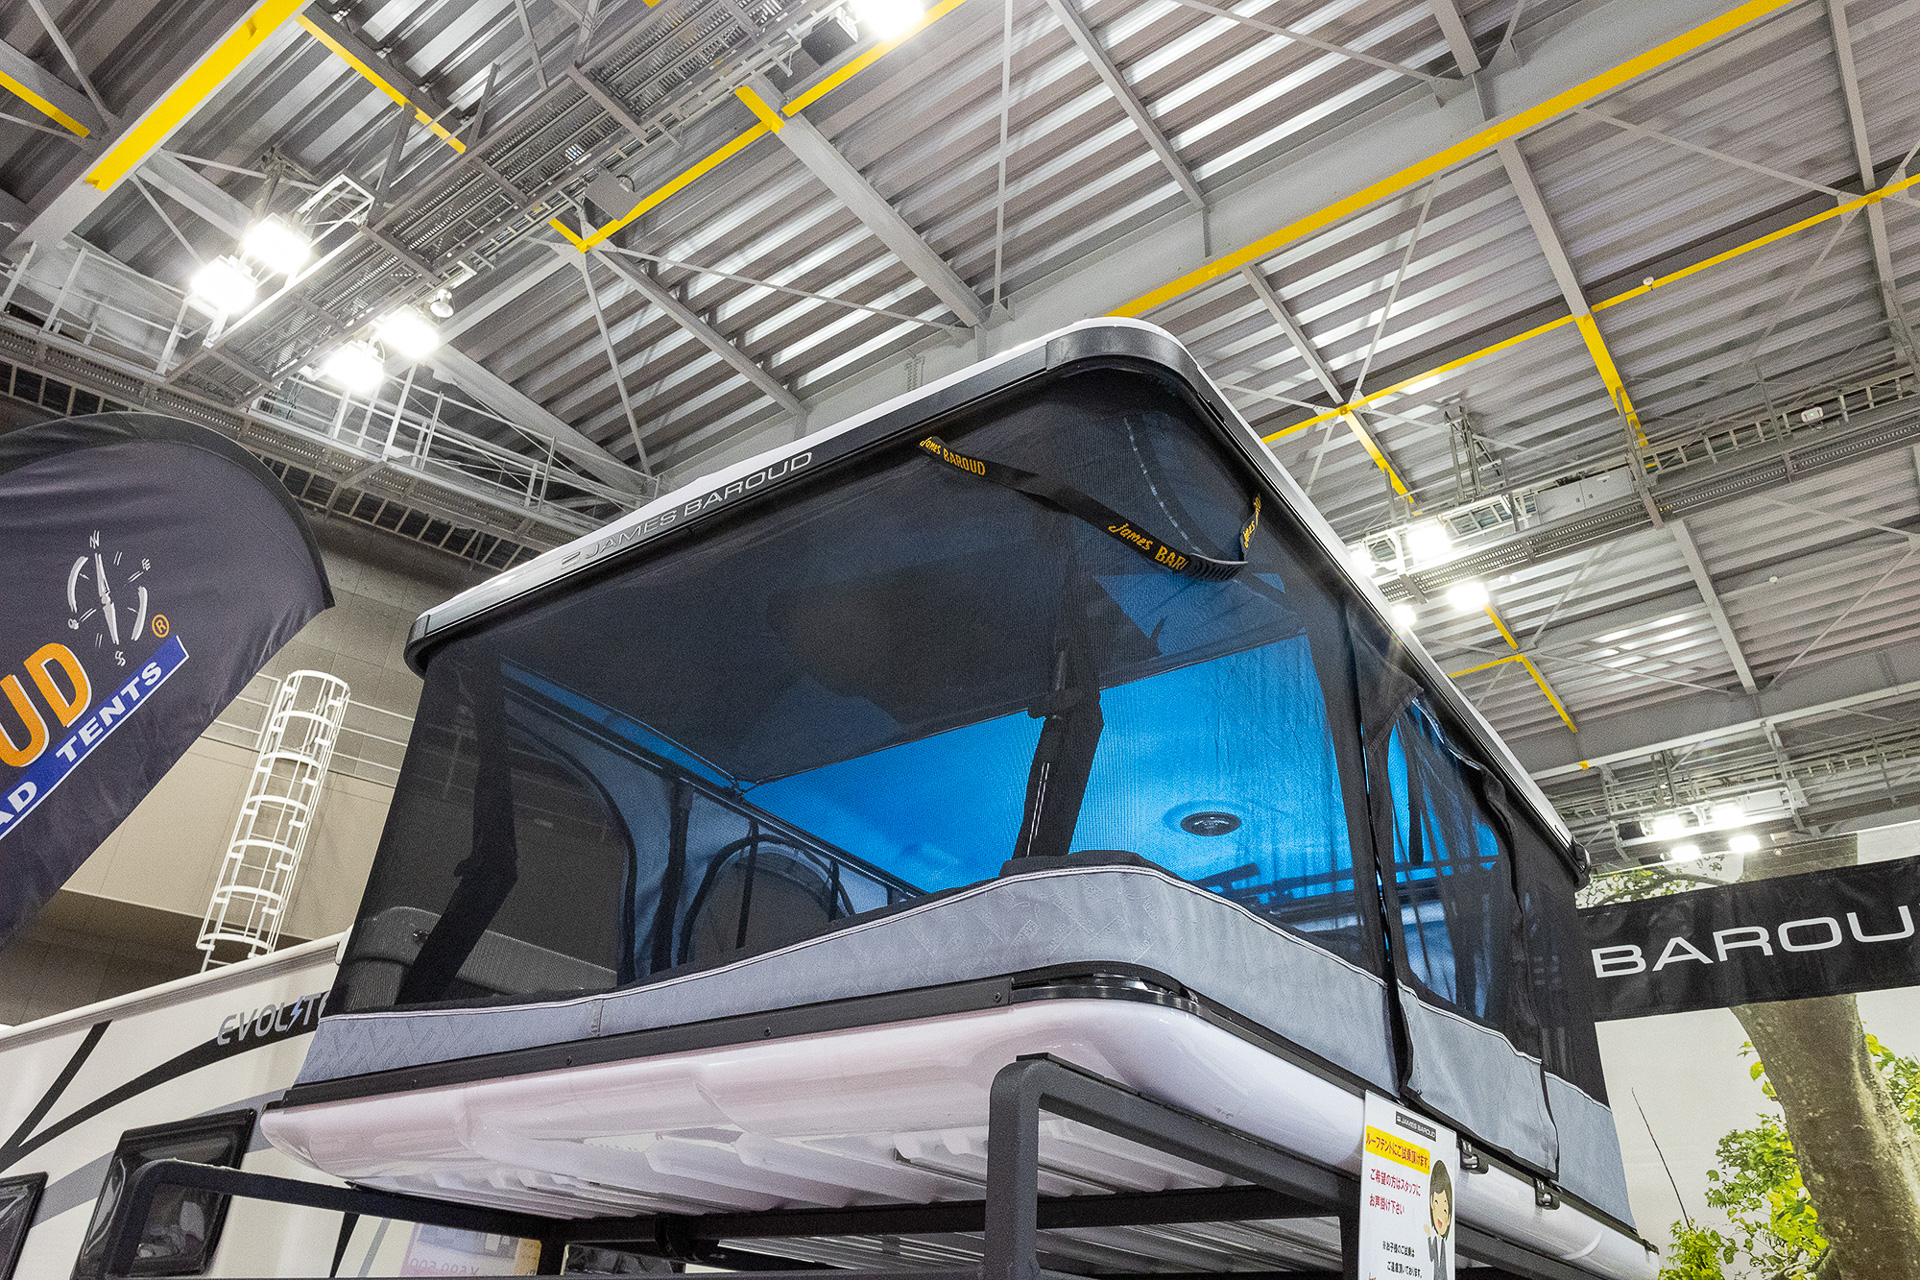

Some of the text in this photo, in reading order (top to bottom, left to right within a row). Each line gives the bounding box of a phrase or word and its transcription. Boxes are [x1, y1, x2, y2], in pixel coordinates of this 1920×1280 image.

[943, 448, 986, 476] BAROUD
[585, 452, 813, 559] JAMES BAROUD
[1108, 523, 1153, 550] James
[0, 643, 92, 767] UD
[55, 661, 162, 763] TENTS
[1591, 902, 1920, 978] BAROU
[1370, 1168, 1421, 1197] ご希望の方はスタッフに
